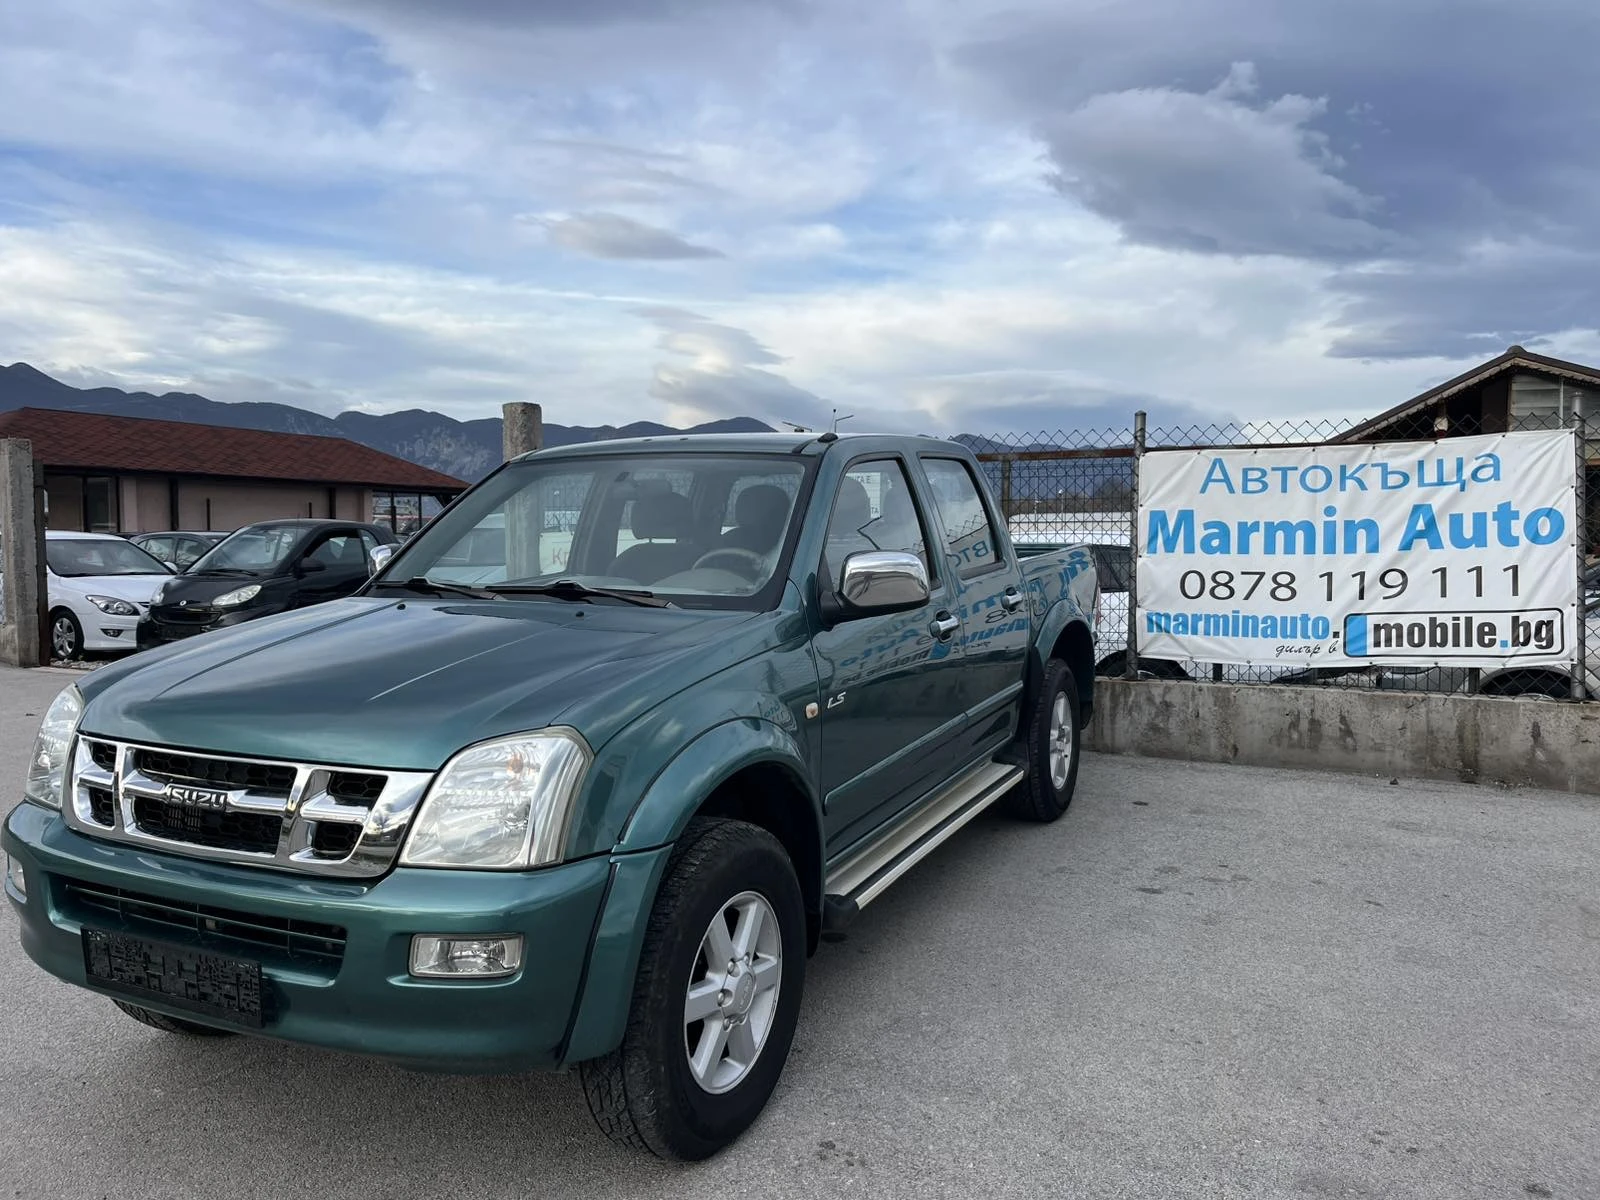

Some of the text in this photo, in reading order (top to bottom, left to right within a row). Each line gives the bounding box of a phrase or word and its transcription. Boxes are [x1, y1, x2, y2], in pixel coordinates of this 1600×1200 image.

[1200, 453, 1501, 492] Автокъща
[1146, 500, 1566, 555] Marmin Auto
[1179, 564, 1519, 601] 0878 119 111
[1373, 615, 1555, 650] mobile.bg
[827, 691, 846, 709] LS
[165, 787, 227, 808] ISUZU
